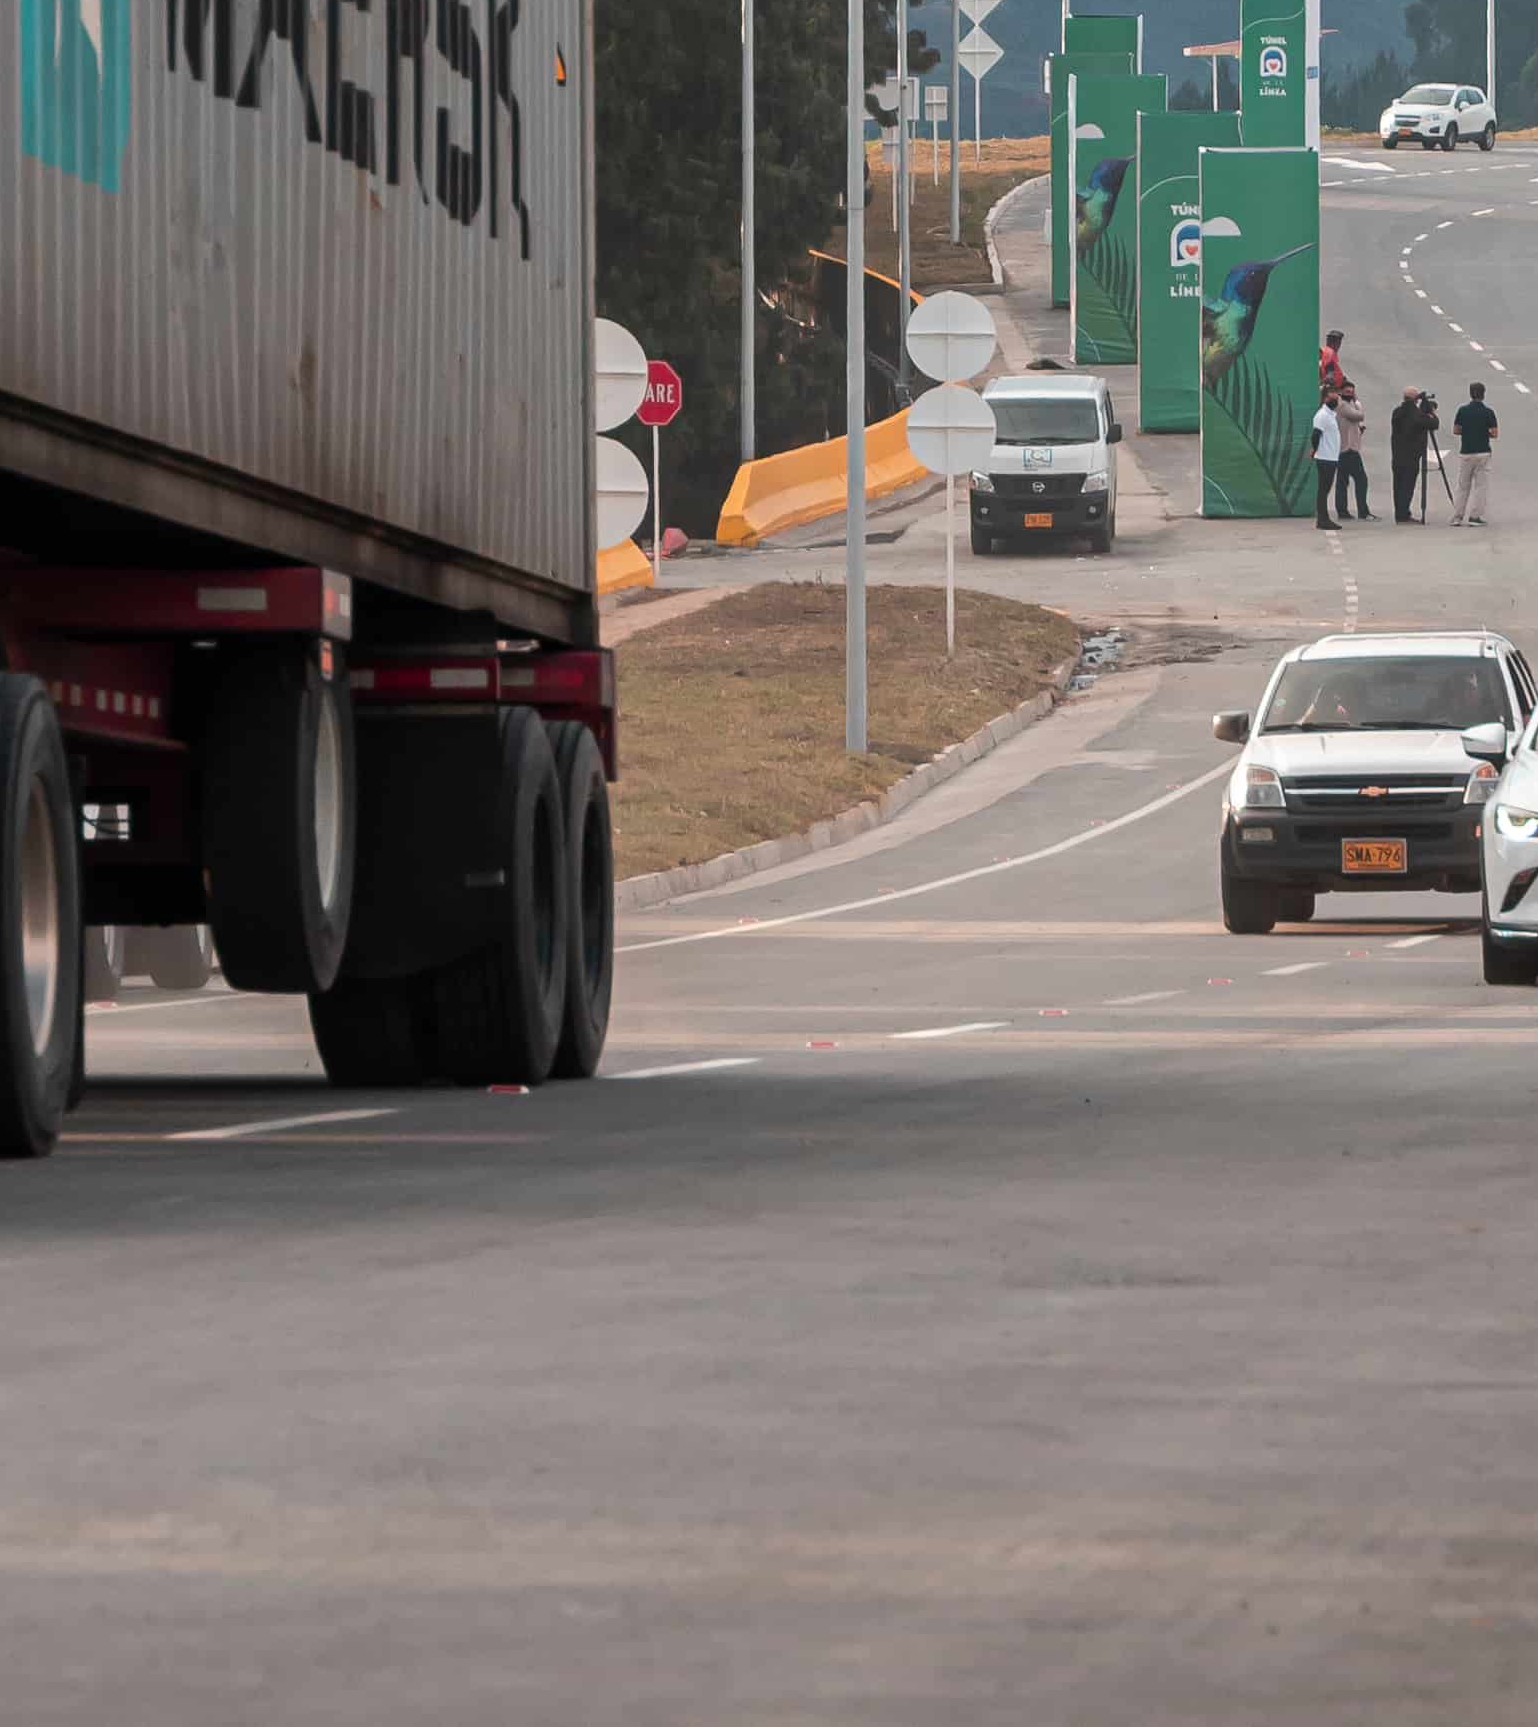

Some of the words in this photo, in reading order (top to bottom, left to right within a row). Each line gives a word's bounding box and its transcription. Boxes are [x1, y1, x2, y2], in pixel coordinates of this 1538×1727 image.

[1170, 201, 1199, 216] TÚN
[1170, 283, 1201, 297] LÍNE
[645, 382, 675, 404] ARE
